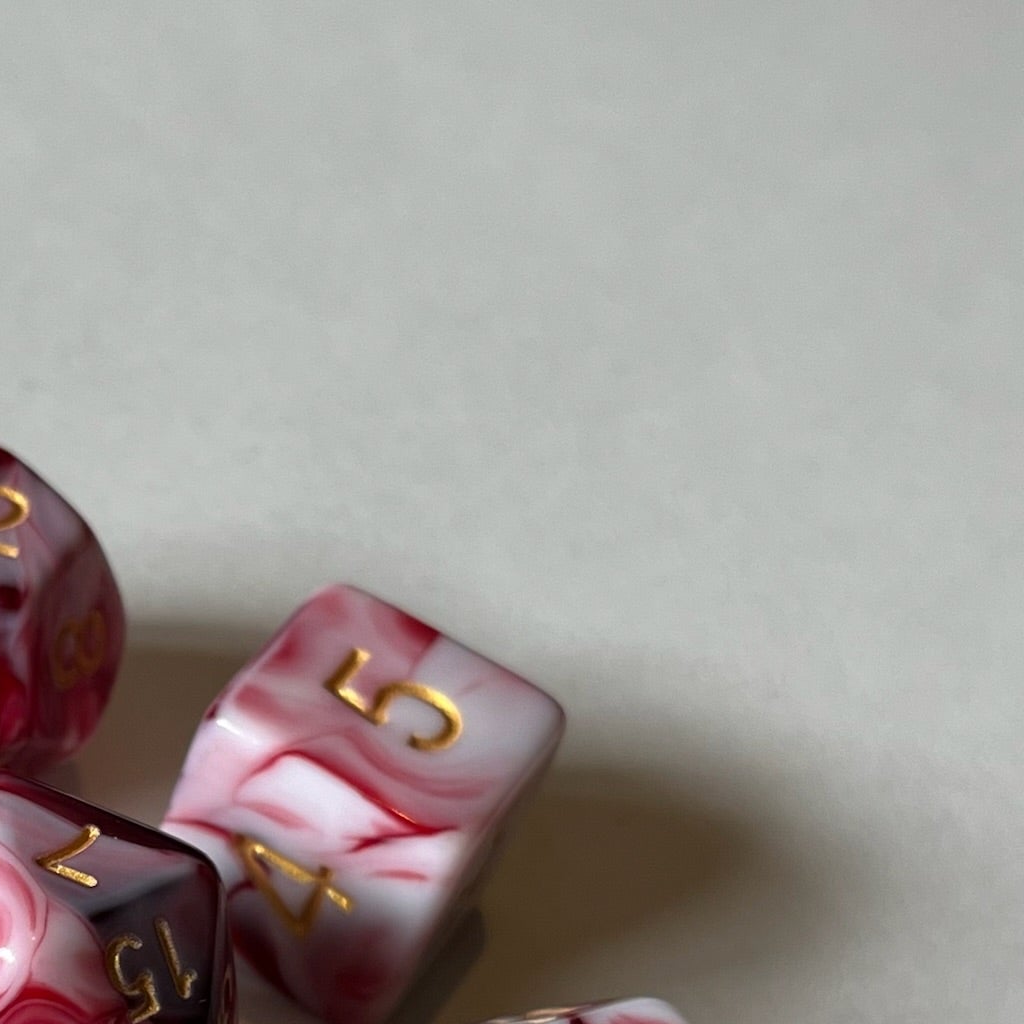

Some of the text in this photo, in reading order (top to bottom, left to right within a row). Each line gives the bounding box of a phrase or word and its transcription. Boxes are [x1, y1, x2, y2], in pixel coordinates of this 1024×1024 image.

[322, 647, 464, 750] 5
[36, 824, 101, 888] 7
[234, 833, 353, 937] 4
[106, 917, 198, 1024] 15
